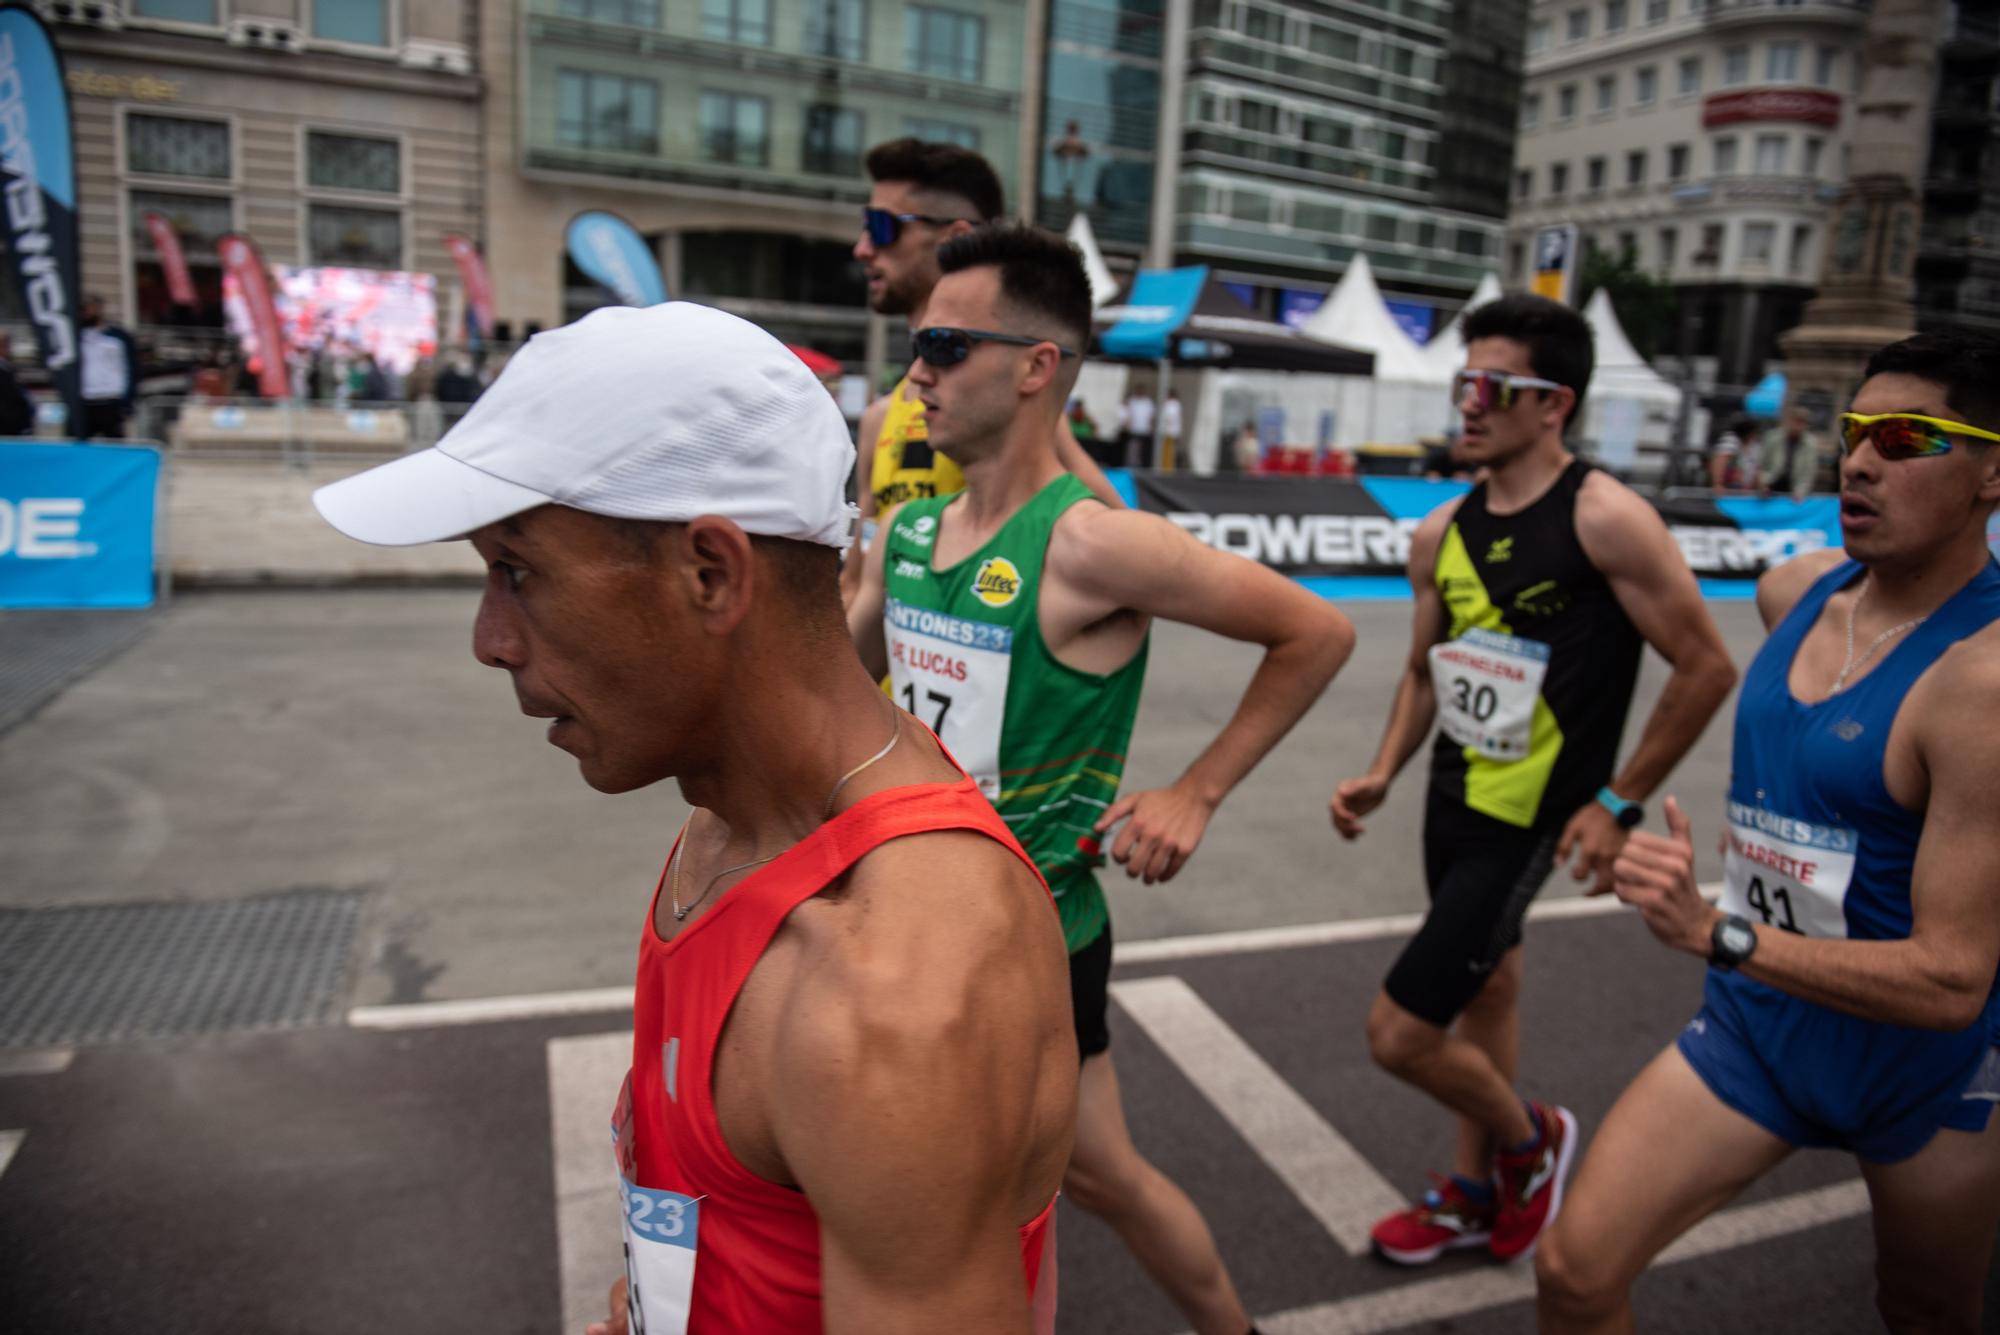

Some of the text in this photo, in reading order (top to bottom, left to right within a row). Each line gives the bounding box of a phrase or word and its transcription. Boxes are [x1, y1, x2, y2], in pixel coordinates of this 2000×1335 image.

[0, 497, 86, 560] E
[909, 647, 968, 682] LUCAS
[901, 682, 953, 738] 17
[1451, 677, 1499, 722] 30
[1747, 874, 1806, 936] 41
